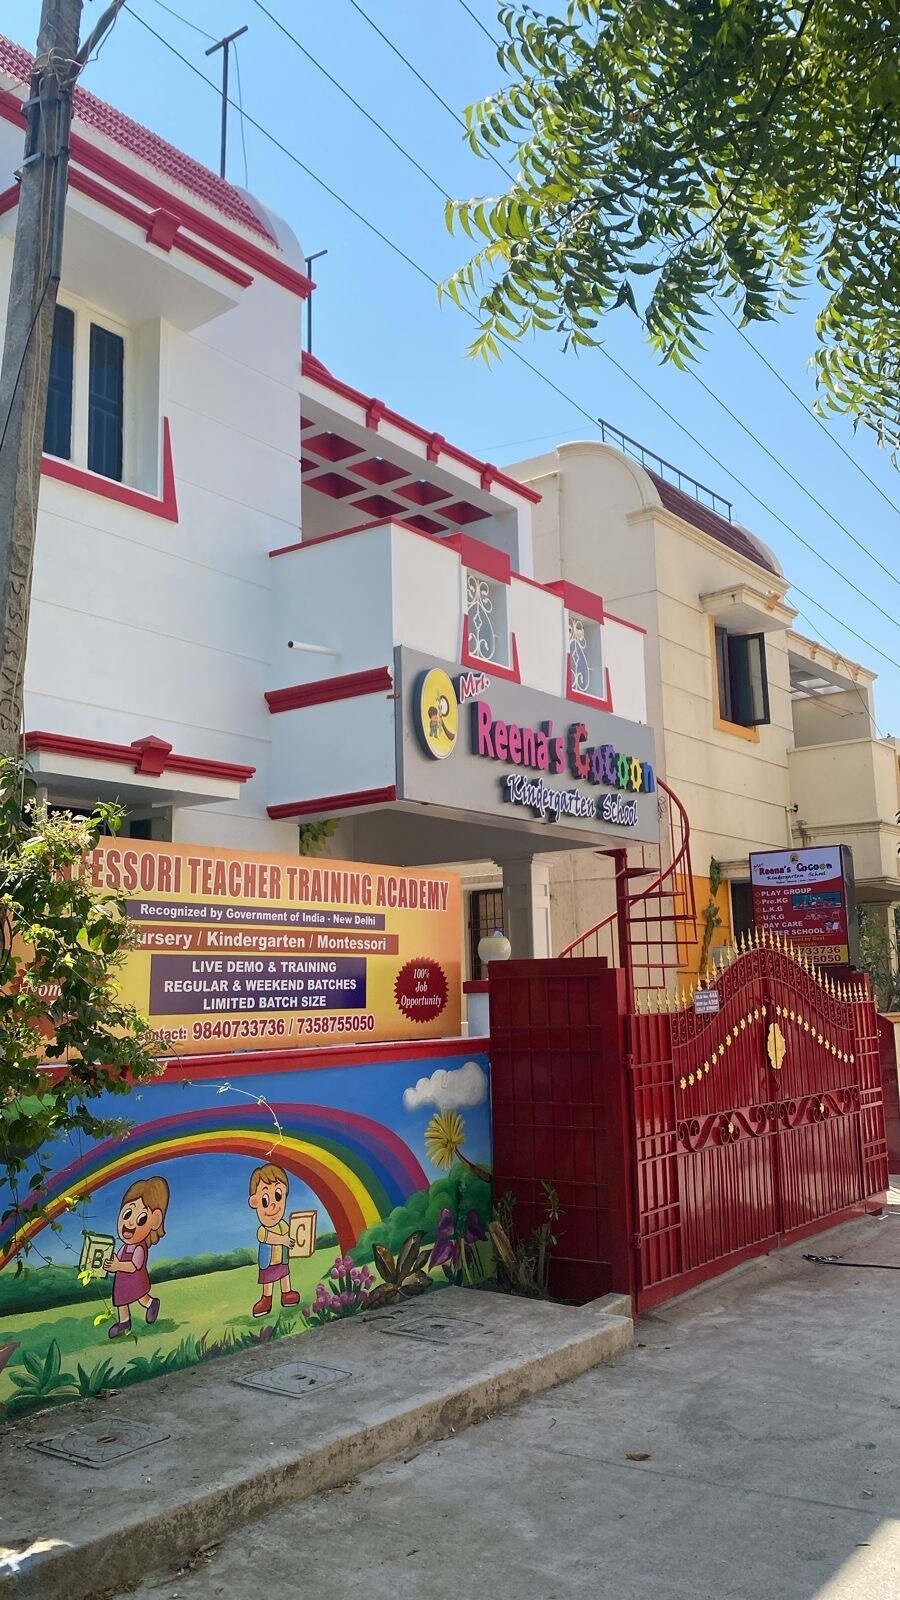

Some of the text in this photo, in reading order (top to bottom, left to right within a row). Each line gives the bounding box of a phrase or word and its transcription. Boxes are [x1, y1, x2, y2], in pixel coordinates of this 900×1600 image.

[460, 672, 490, 704] Mrs.
[475, 700, 656, 793] Reena's Cocoon
[506, 774, 639, 826] Kindergarten School
[759, 862, 833, 876] Reena's Cocoon
[187, 857, 282, 900] TEACHER
[287, 867, 372, 906] TRAINING
[376, 875, 449, 911] ACADEMY
[783, 887, 812, 895] GROUP
[140, 903, 207, 919] Recognized
[210, 907, 223, 920] by
[226, 908, 288, 922] Government
[290, 911, 300, 922] of
[302, 912, 325, 923] India
[333, 914, 352, 924] New
[354, 915, 376, 926] Delhi
[133, 931, 193, 950] ursery
[207, 931, 305, 950] Kindergarten
[317, 934, 387, 951] Montessori
[192, 961, 337, 973] LIVE DEMO & TRAINING
[413, 968, 430, 979] 100%
[164, 979, 357, 993] REGULAR & WEEKEND BATCHES
[415, 982, 428, 993] Job
[203, 995, 327, 1010] LIMITED BATCH SIZE
[401, 995, 442, 1008] Opportunity
[192, 1018, 285, 1040] 9840733736
[297, 1015, 375, 1034] 7358755050
[296, 1224, 305, 1247] C
[94, 1249, 104, 1268] B
